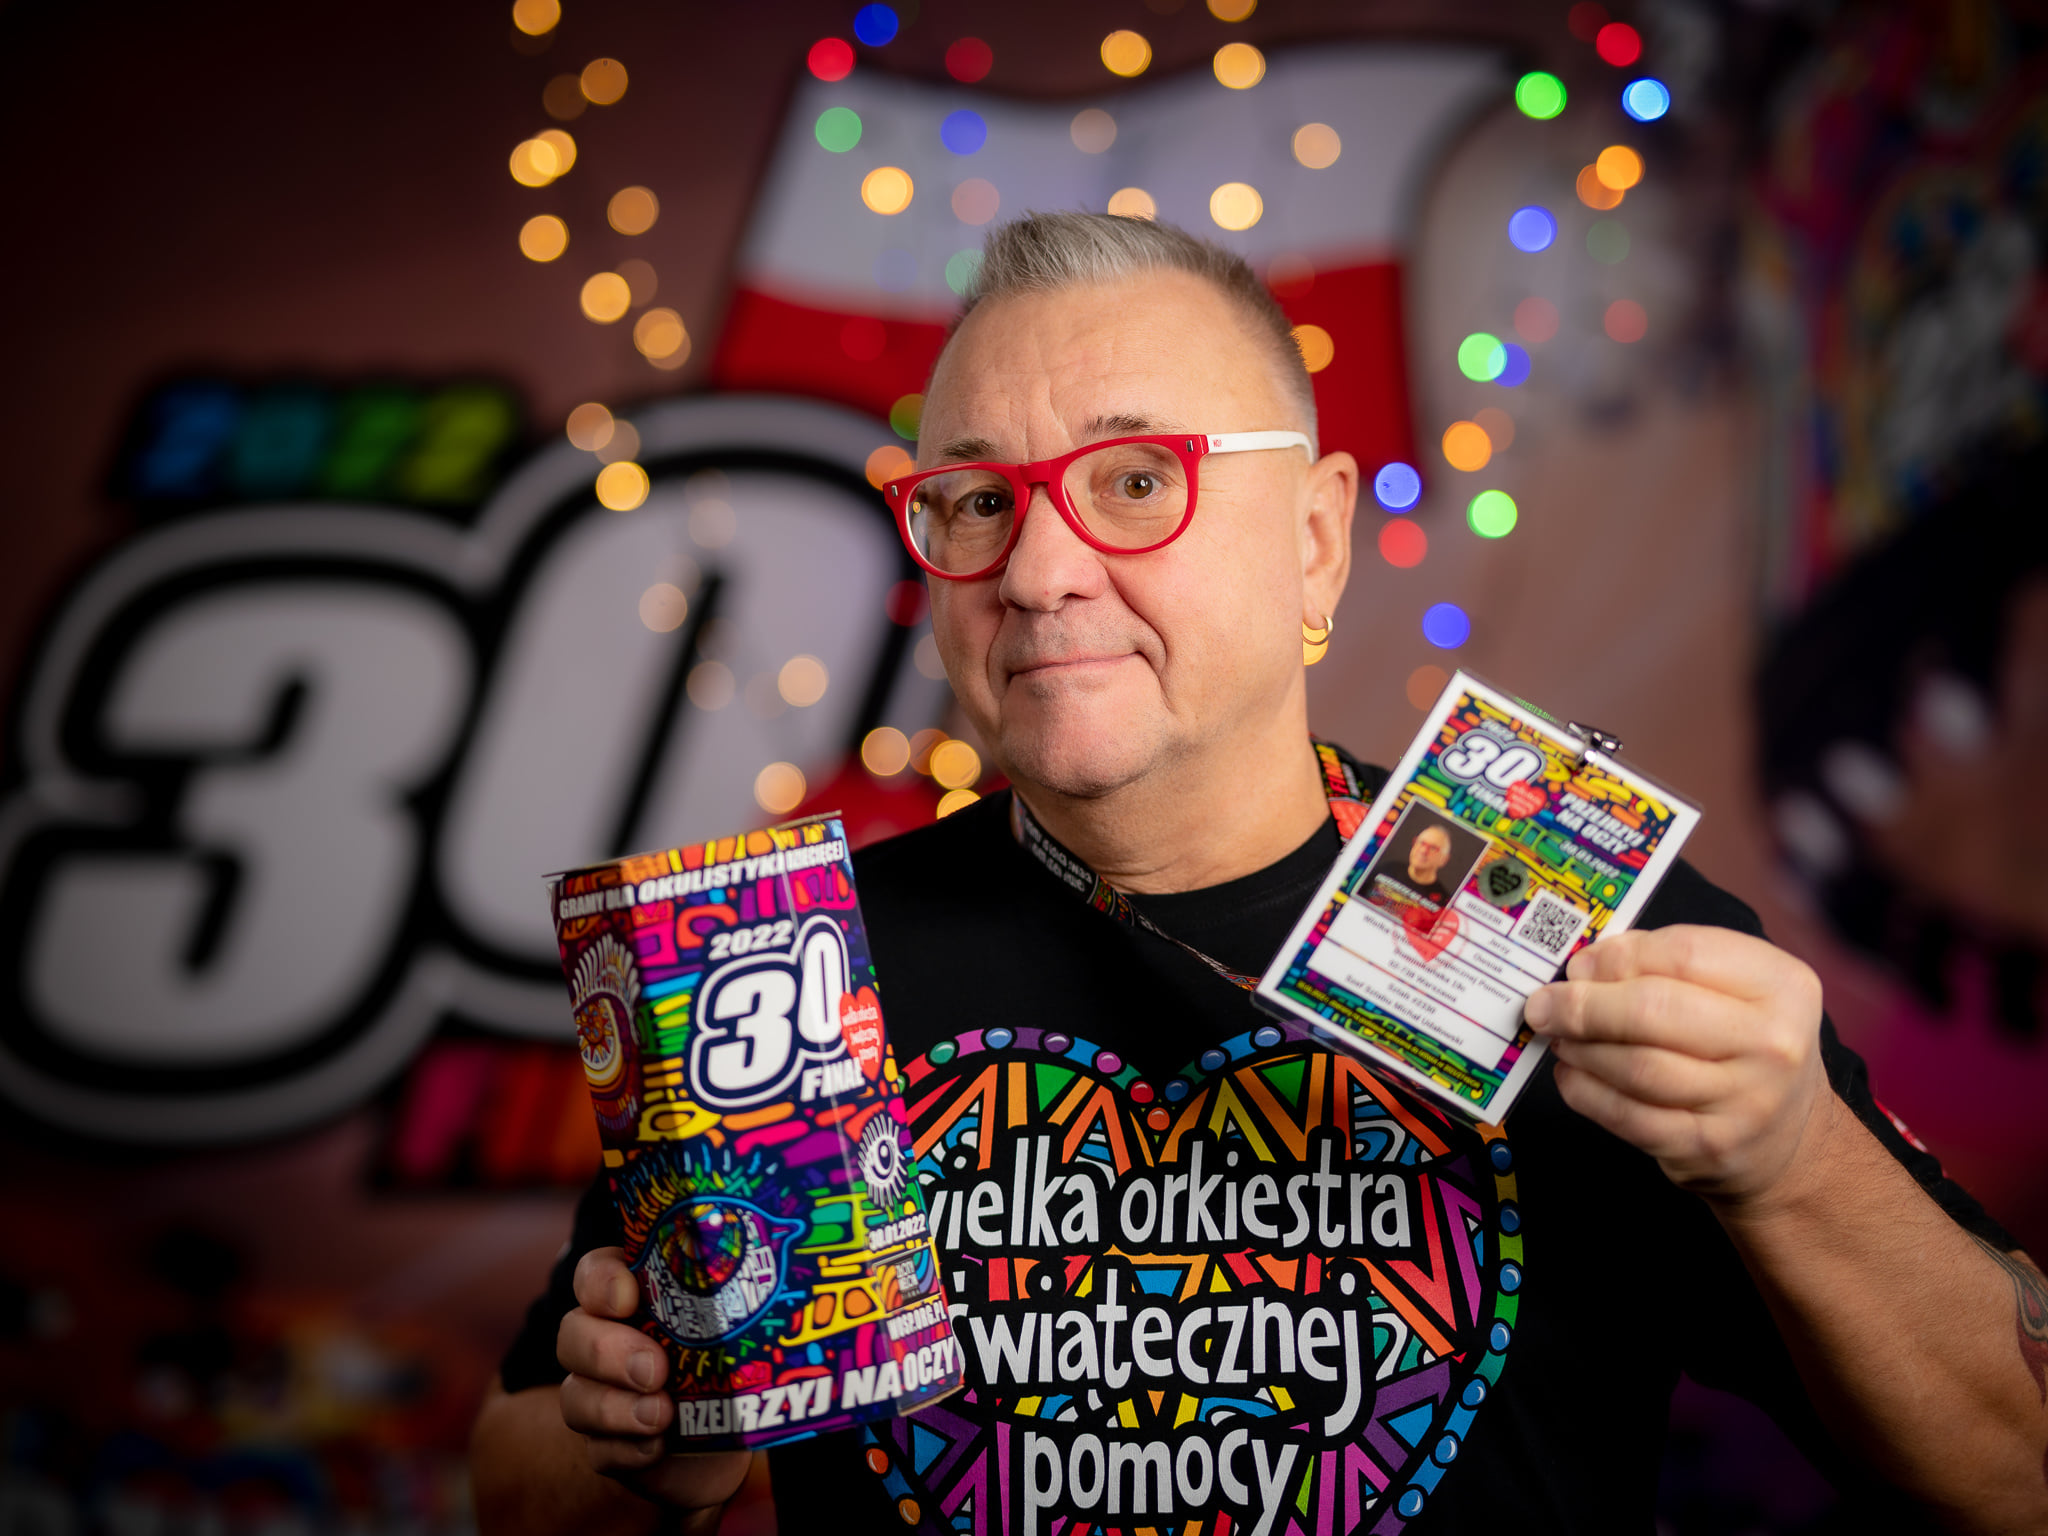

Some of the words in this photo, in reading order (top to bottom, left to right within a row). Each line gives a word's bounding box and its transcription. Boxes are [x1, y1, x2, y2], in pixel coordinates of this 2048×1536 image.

[20, 468, 908, 1063] 30
[1440, 731, 1545, 790] 30
[1554, 808, 1586, 831] NA
[1579, 823, 1630, 857] OCZY
[559, 892, 603, 920] GRAMY
[605, 884, 636, 909] DLA
[637, 852, 785, 904] OKULISTYKI
[708, 919, 795, 961] 2022
[704, 928, 846, 1093] 30
[869, 1213, 927, 1251] 30.01.2022
[929, 1135, 1099, 1250] ielka
[1120, 1138, 1412, 1248] orkiestra
[678, 1375, 835, 1437] RZEJRZYJ
[841, 1359, 903, 1410] NA
[902, 1336, 955, 1392] OCZY
[1024, 1428, 1300, 1536] pomocy
